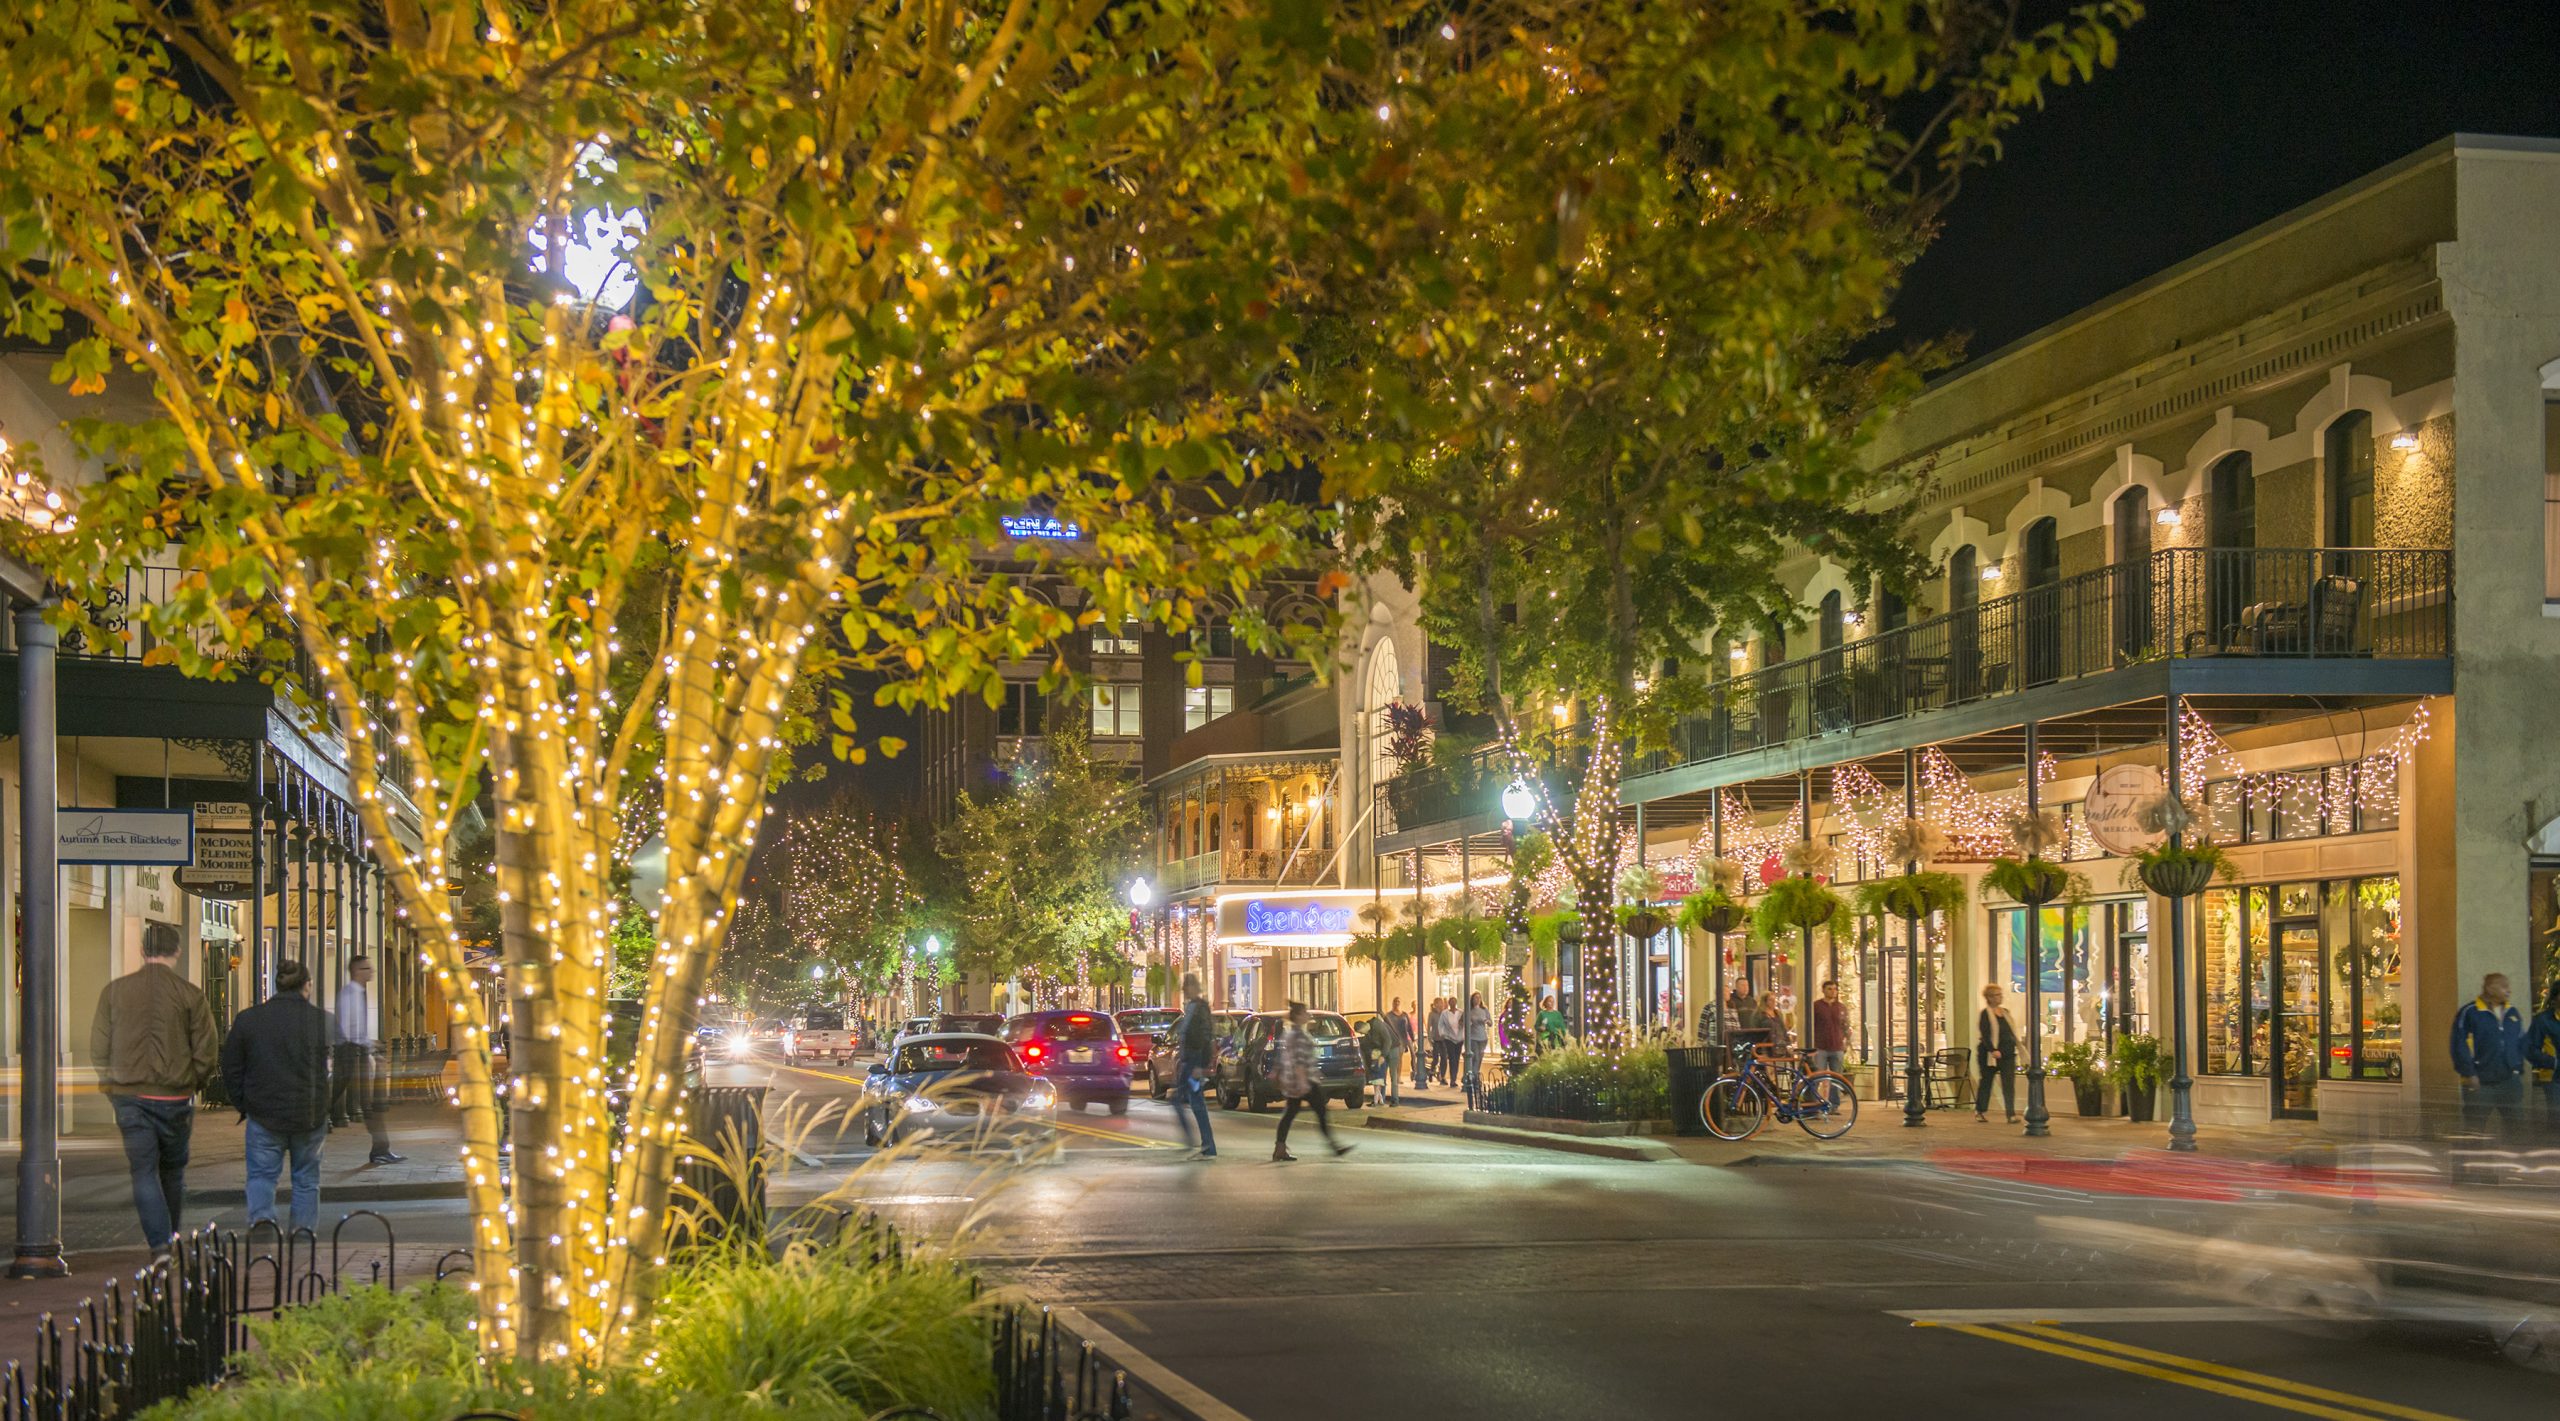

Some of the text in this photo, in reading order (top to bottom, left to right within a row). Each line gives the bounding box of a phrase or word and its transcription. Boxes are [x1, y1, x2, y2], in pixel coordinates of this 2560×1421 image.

[208, 801, 238, 815] Clear
[2103, 825, 2145, 834] MERCAN
[59, 834, 182, 847] Autumn Beck Blackledge
[200, 860, 267, 870] MOORHE
[218, 884, 235, 892] 127
[1248, 901, 1352, 935] Saenger
[2361, 1046, 2402, 1059] FURNITUR
